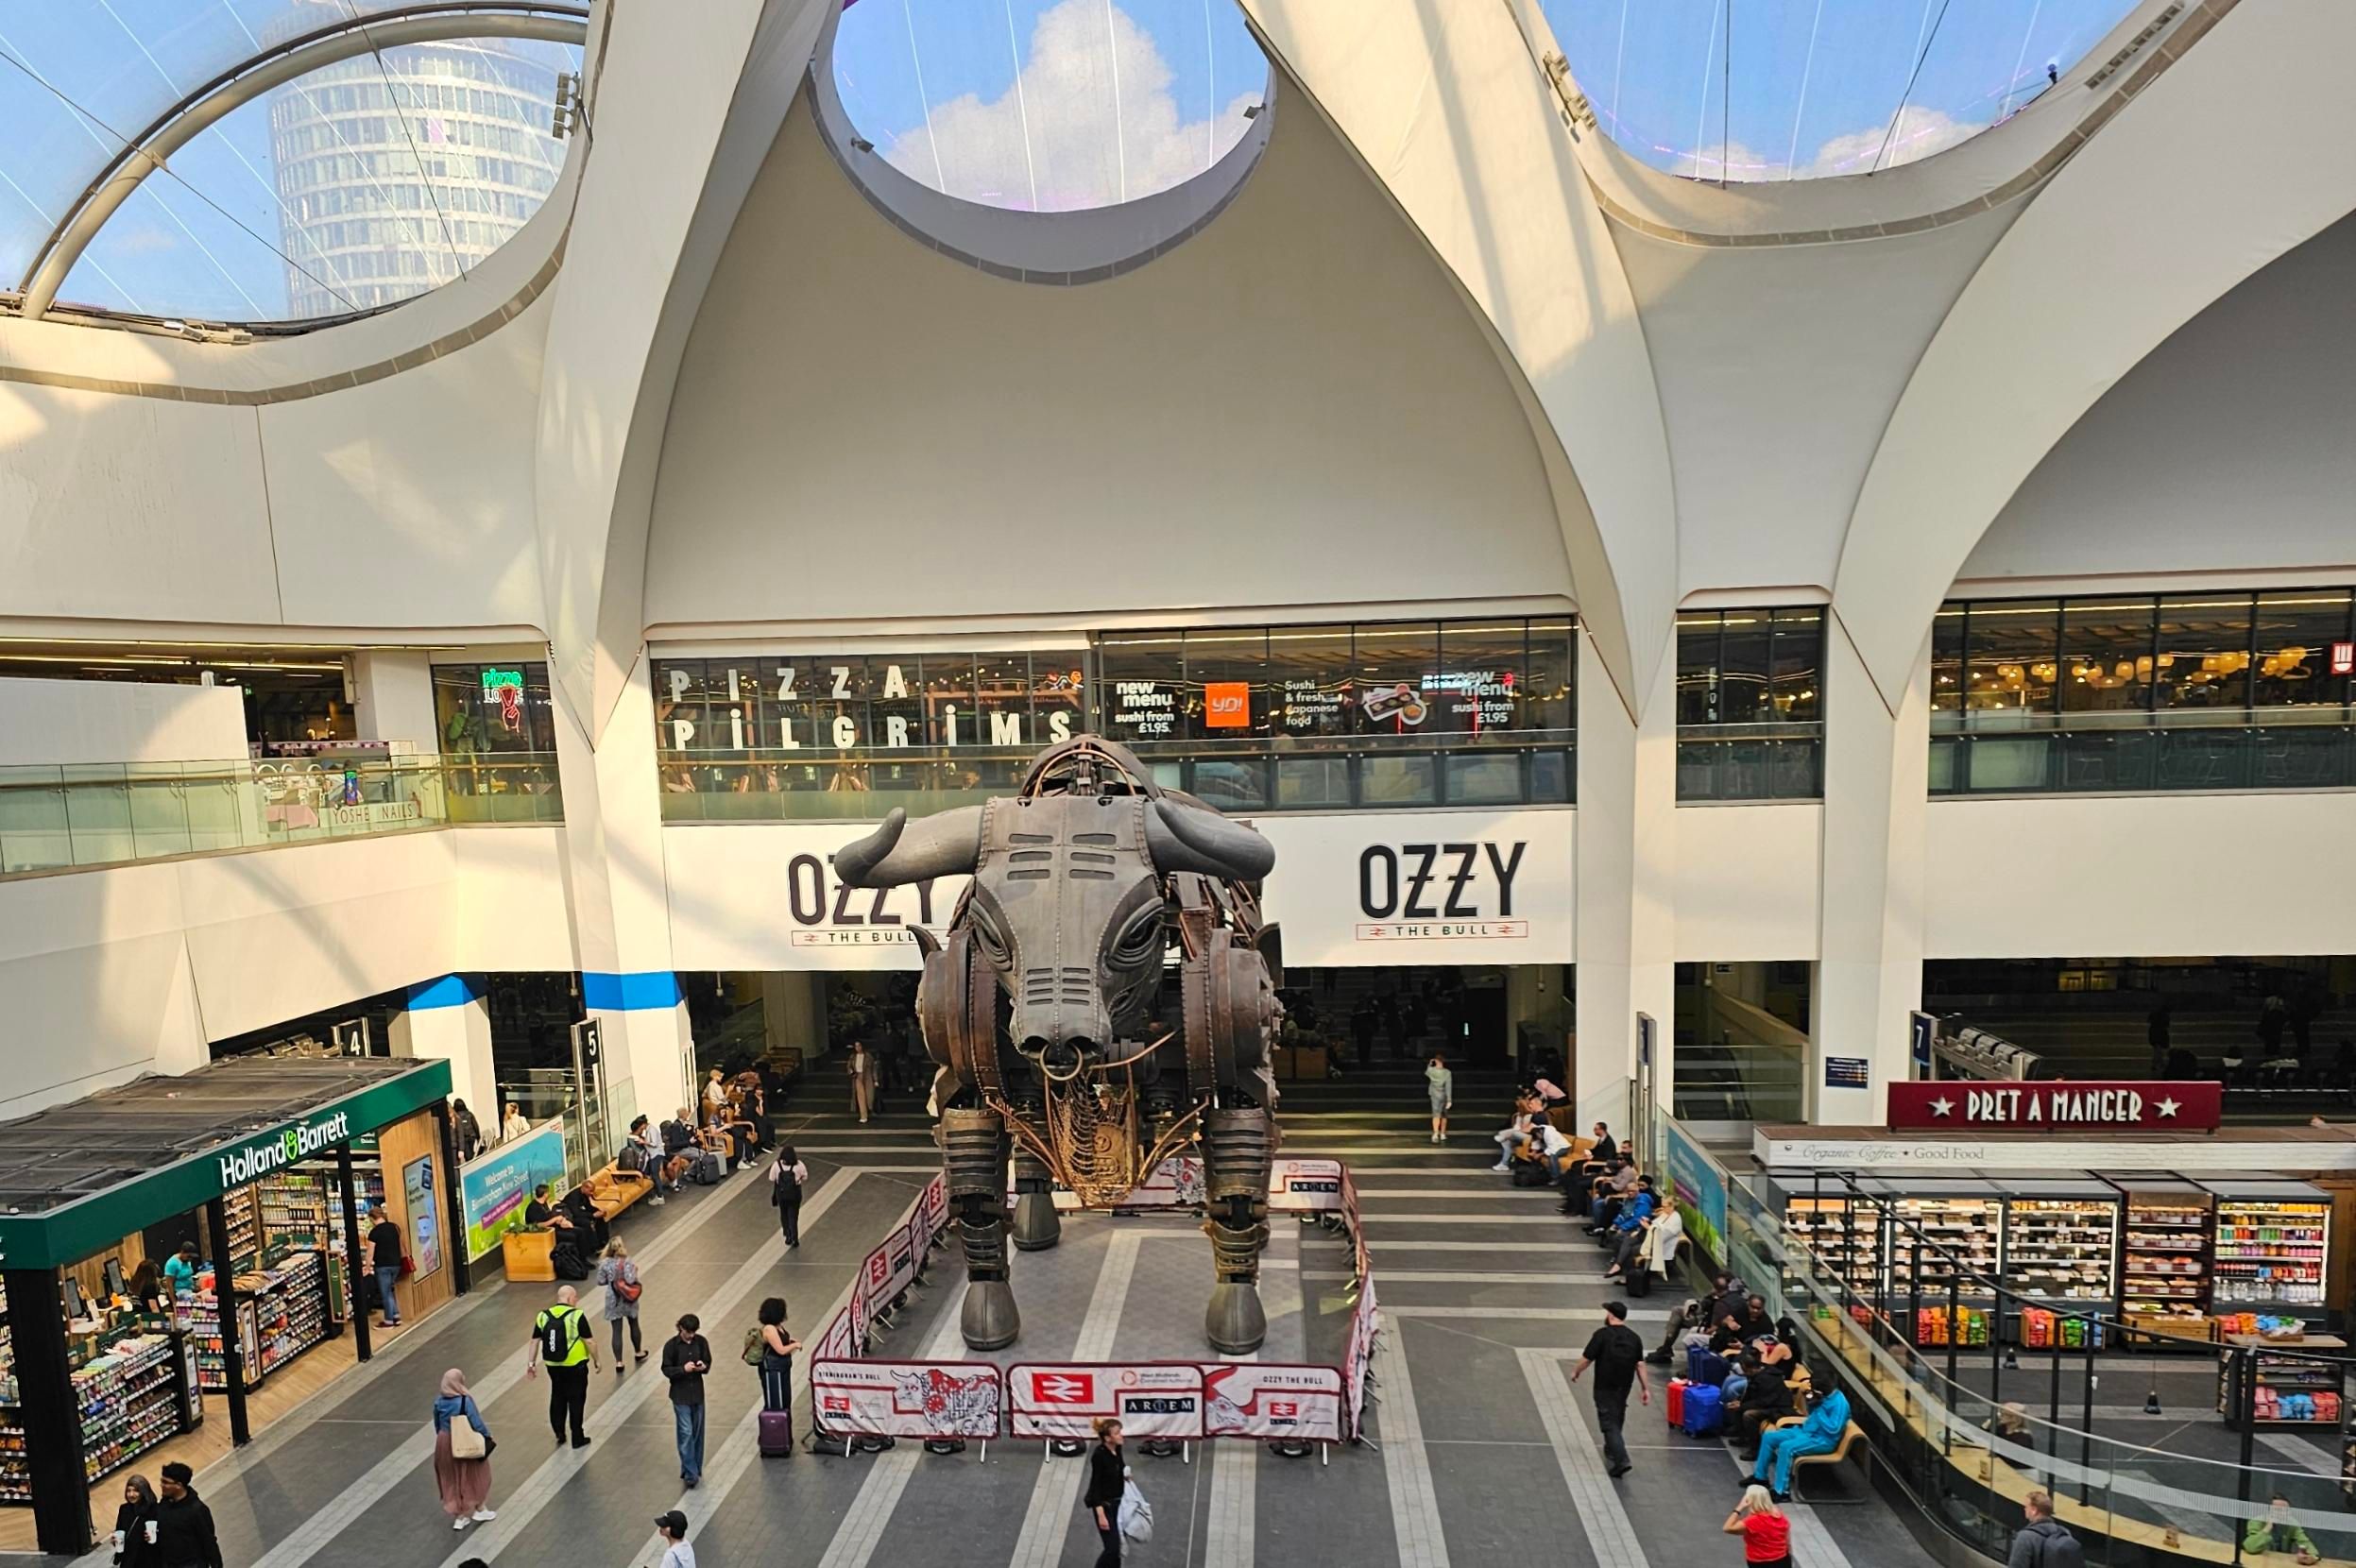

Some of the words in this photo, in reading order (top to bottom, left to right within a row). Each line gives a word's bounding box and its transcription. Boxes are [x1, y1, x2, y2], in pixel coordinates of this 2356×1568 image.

[670, 665, 908, 703] PIZZA
[1117, 682, 1155, 695] new
[1285, 680, 1315, 690] Sushi
[1122, 693, 1173, 707] menu
[1285, 692, 1294, 703] &
[1296, 691, 1324, 703] fresh
[1452, 701, 1482, 713] sushi
[1484, 701, 1514, 711] from
[1115, 711, 1145, 723] sushi
[1146, 710, 1174, 722] from
[1286, 715, 1311, 726] food
[1138, 722, 1169, 734] £1.95
[382, 803, 413, 820] NAILS
[1360, 842, 1527, 919] OZZY
[828, 932, 861, 943] THE
[872, 931, 914, 942] BULL
[1396, 926, 1430, 936] THE
[1443, 925, 1489, 935] BULL
[1915, 1024, 1923, 1049] 7
[350, 1031, 361, 1056] 4
[588, 1030, 597, 1057] 5
[1967, 1089, 2022, 1121] PRET
[2027, 1090, 2042, 1121] A
[2051, 1089, 2143, 1121] MANGER
[220, 1133, 287, 1187] Holland
[297, 1111, 350, 1155] Barrett
[1802, 1144, 1854, 1162] Organic
[1858, 1144, 1898, 1163] Coffee
[1914, 1147, 1949, 1160] Good
[1953, 1147, 1984, 1160] Food
[1263, 1375, 1282, 1384] OZZY
[1304, 1376, 1323, 1385] BULL
